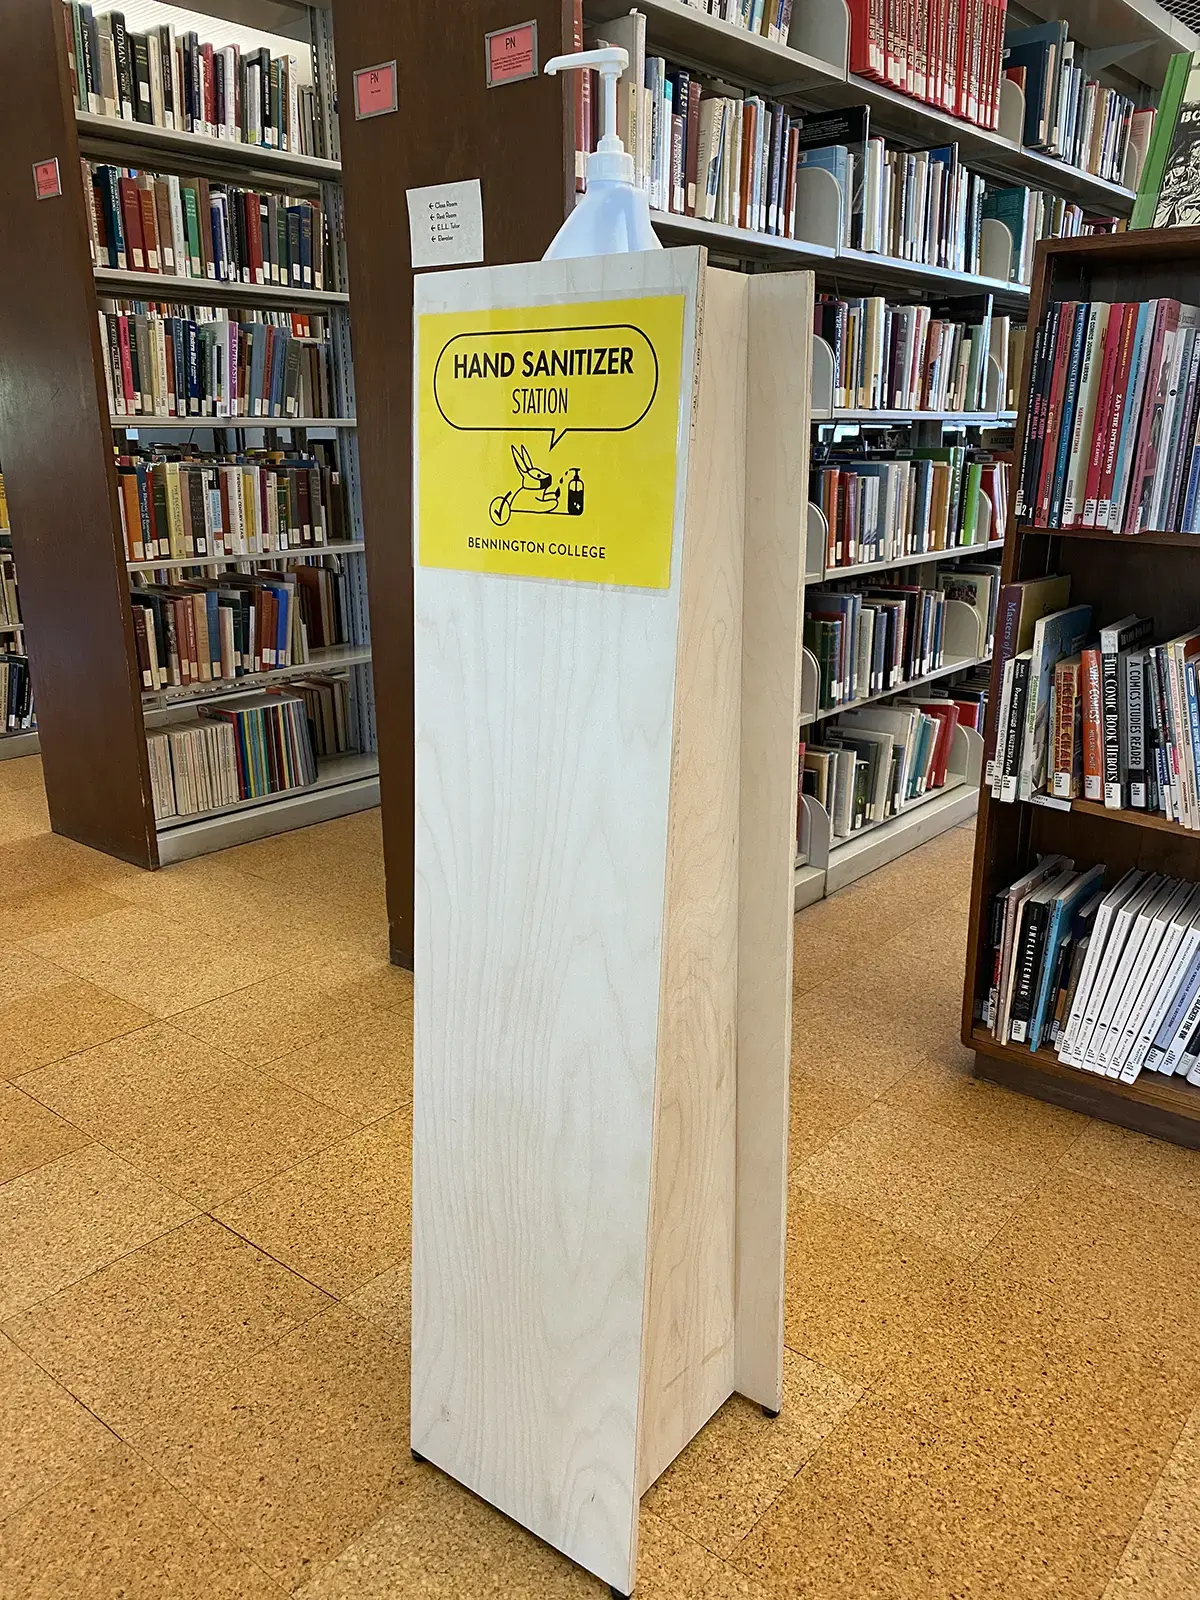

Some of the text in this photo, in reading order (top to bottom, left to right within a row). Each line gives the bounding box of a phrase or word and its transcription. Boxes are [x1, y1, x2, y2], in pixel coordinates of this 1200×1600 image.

[116, 23, 126, 64] LOTMAN
[505, 36, 516, 50] PN
[370, 72, 379, 84] PN
[453, 346, 634, 379] HAND SANITIZER
[1071, 348, 1080, 378] JOURNAL
[1180, 348, 1190, 370] COMICS
[512, 387, 568, 414] STATION
[1067, 378, 1076, 404] LIBRARY
[1114, 394, 1123, 411] ZAP:
[1073, 407, 1084, 454] HARVEY KURTZMAN
[1105, 429, 1117, 475] INTERVIEWS
[1021, 505, 1026, 516] 2
[1029, 507, 1033, 519] 1
[1037, 507, 1042, 518] 3
[467, 536, 606, 559] BENNINGTON COLLEGE
[1004, 602, 1016, 639] Masters
[1001, 641, 1012, 652] of
[1013, 687, 1022, 708] Drawing
[1090, 664, 1100, 724] WHY COMICS?
[1129, 670, 1141, 700] COMICS
[1061, 672, 1075, 729] MICHAEL
[1104, 659, 1119, 781] THE COMIC BOOK HEROES
[1130, 703, 1141, 734] STUDIES
[1130, 736, 1141, 766] READER
[1097, 911, 1107, 936] AMERICAN
[1116, 915, 1126, 940] AMERICAN
[1146, 928, 1158, 951] AMERICAN
[1164, 930, 1176, 953] AMERICAN
[1020, 925, 1038, 996] UNFLATTENING
[1157, 954, 1166, 968] COMIC
[1168, 936, 1194, 988] AMERICAN COMIC BOOK
[1183, 1020, 1194, 1031] THE
